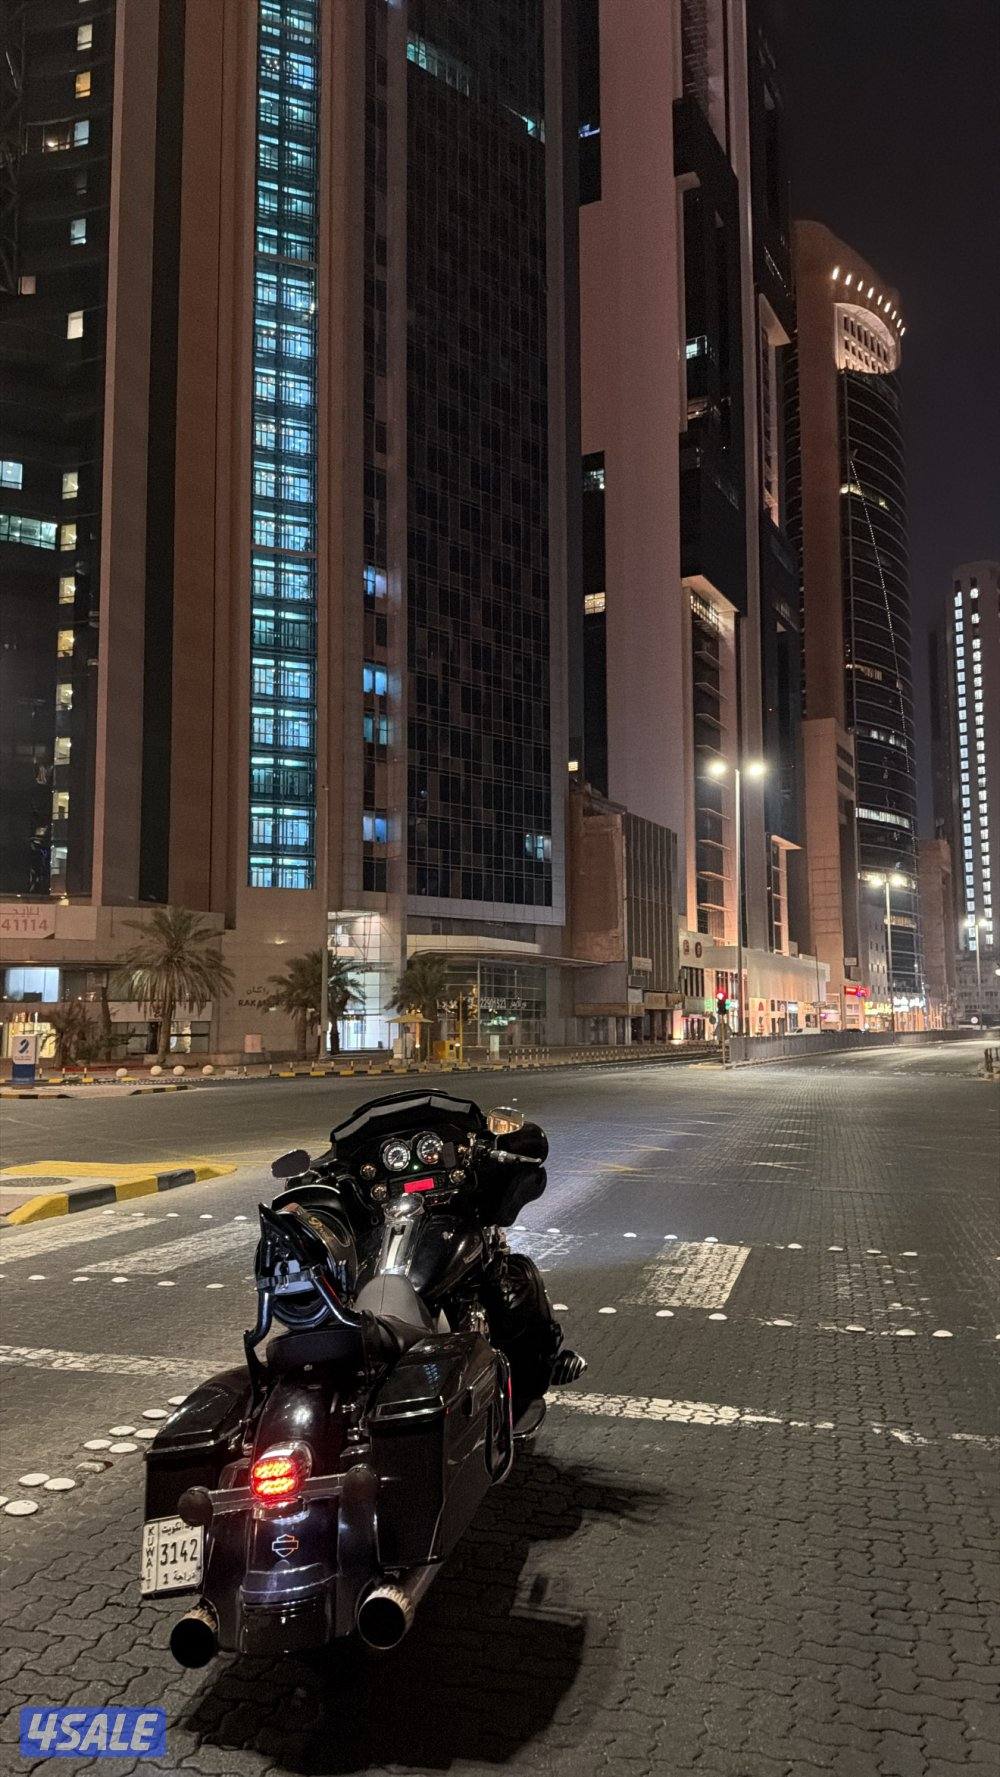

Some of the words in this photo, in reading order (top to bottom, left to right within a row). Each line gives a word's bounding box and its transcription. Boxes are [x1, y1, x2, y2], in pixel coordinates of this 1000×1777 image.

[146, 1526, 155, 1589] KUWAIT
[160, 1539, 198, 1566] 3142
[162, 1573, 169, 1585] 1
